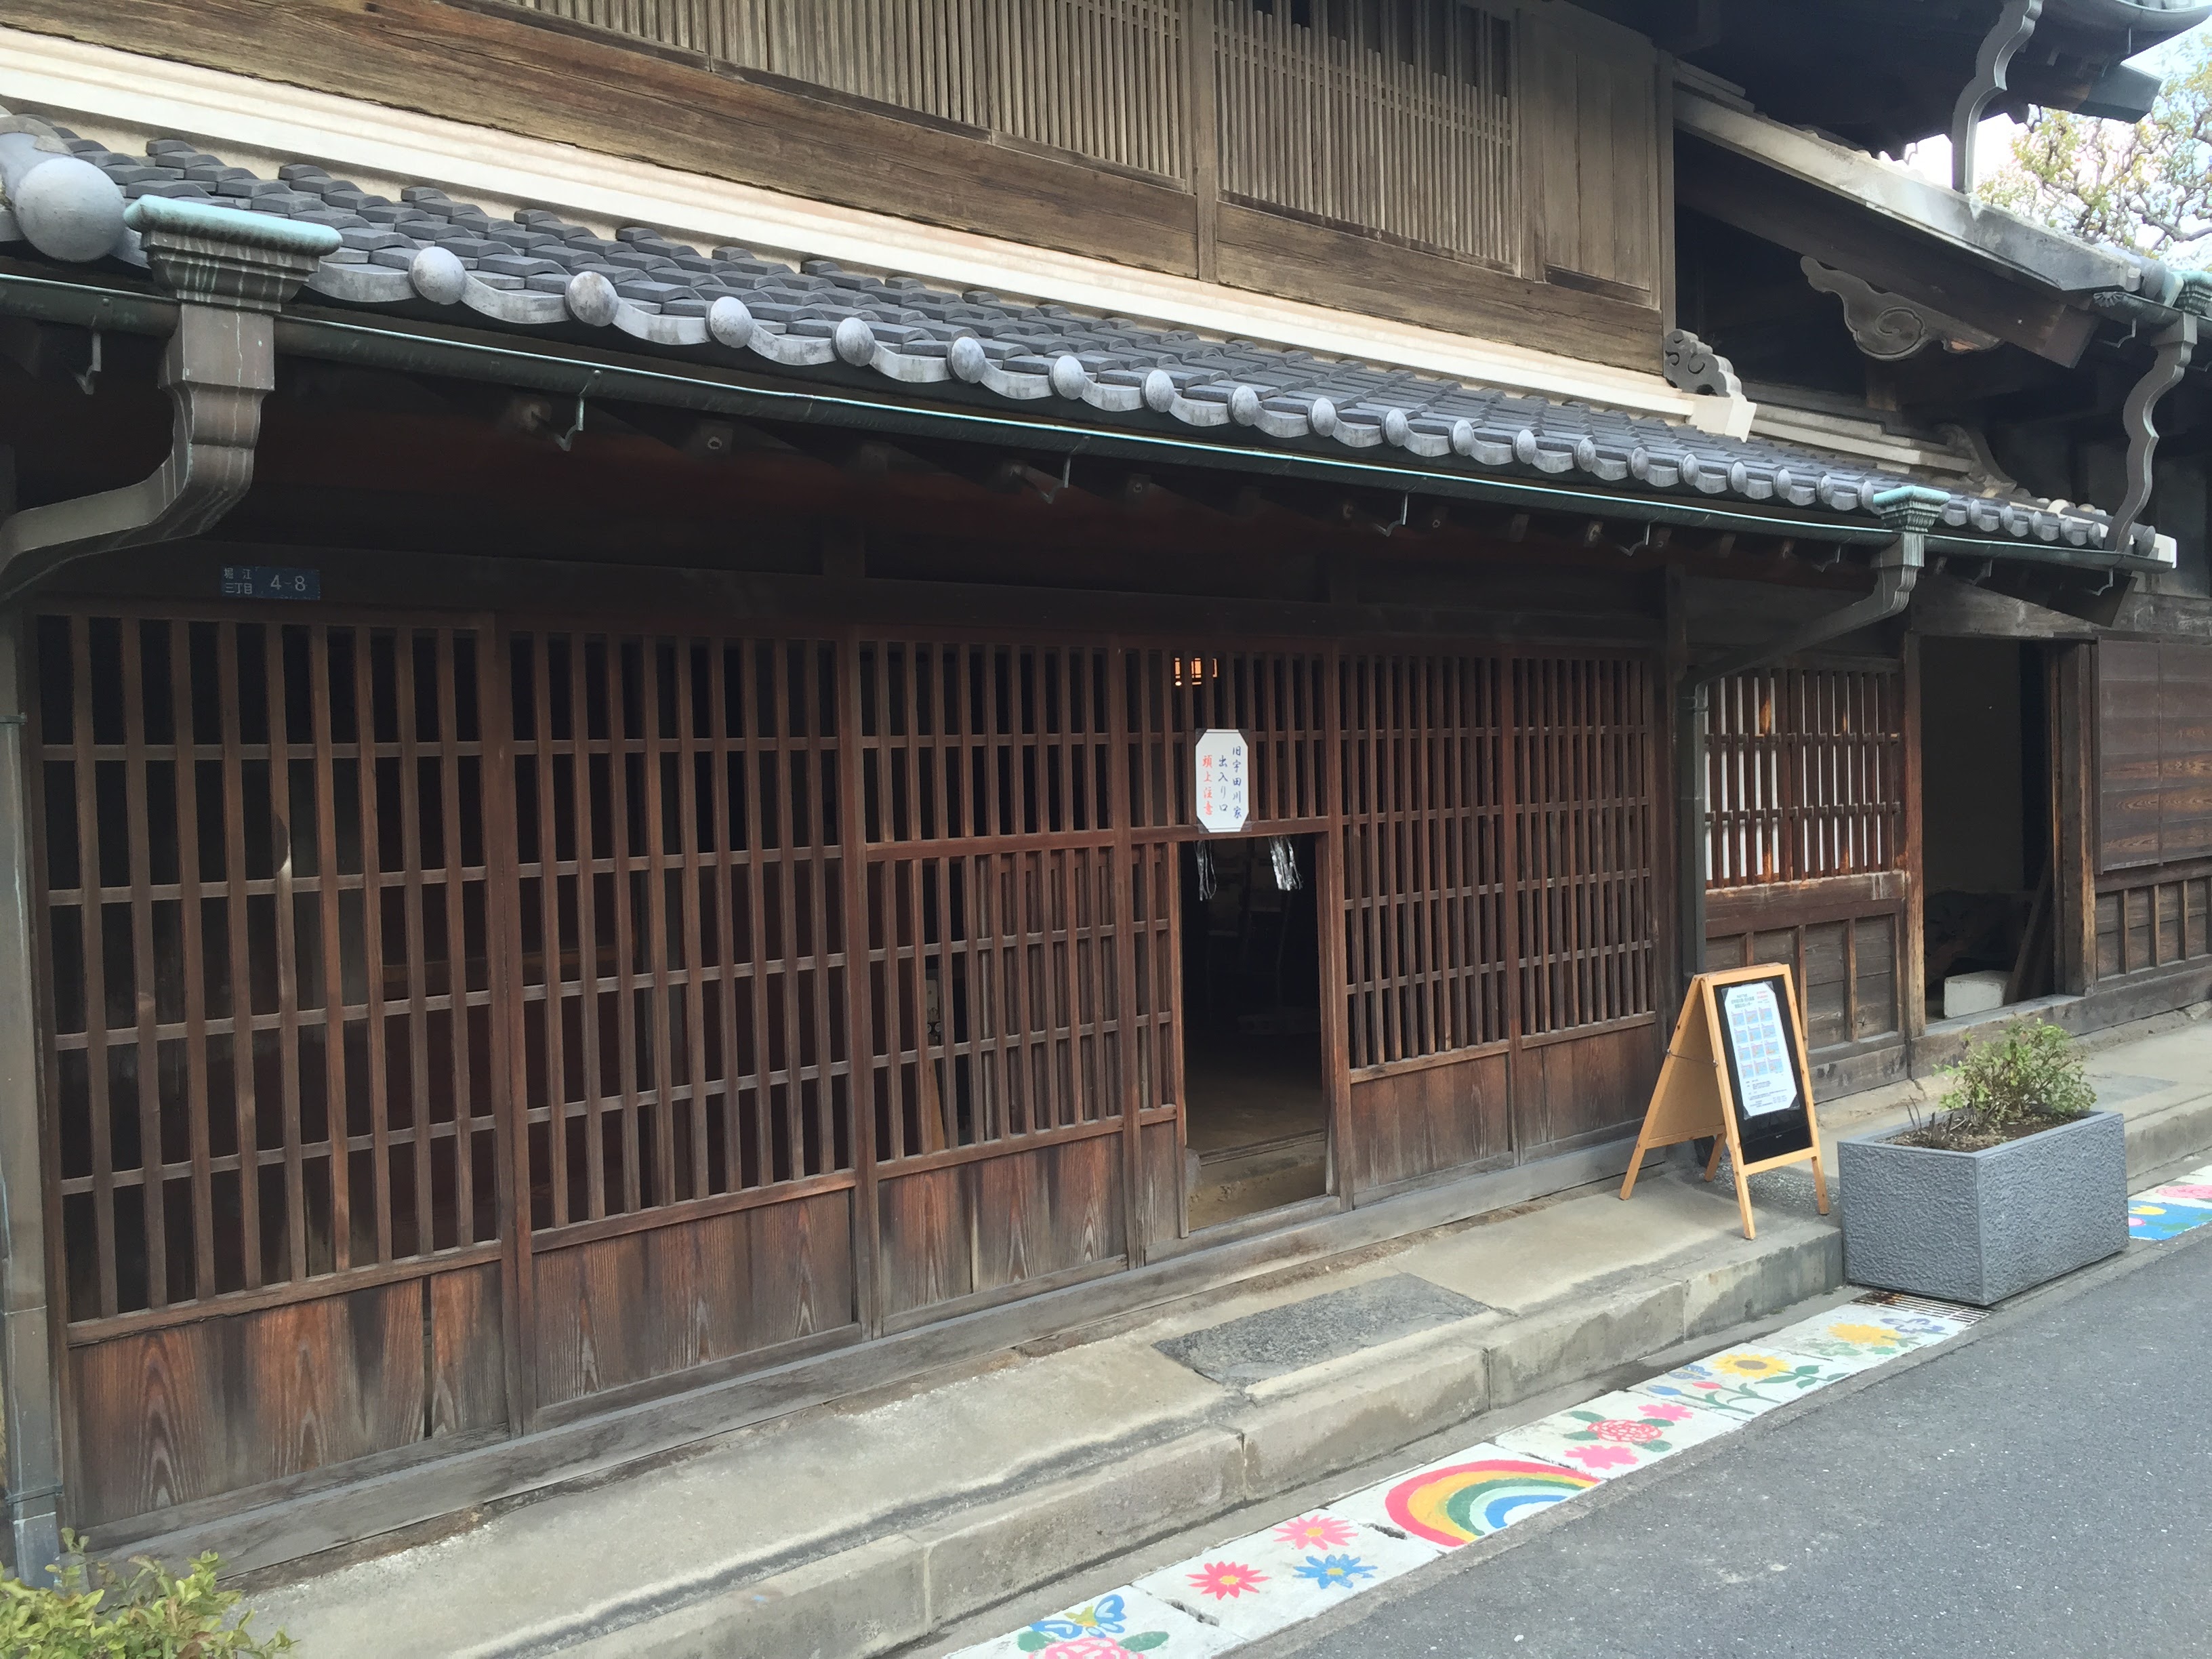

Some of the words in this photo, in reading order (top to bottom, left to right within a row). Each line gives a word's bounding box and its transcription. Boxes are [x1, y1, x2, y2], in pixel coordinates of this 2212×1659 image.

[224, 567, 252, 579] 堀江
[225, 582, 253, 594] 三丁目
[1202, 755, 1213, 815] 頭上注意
[1218, 754, 1228, 811] 出入り口
[1232, 745, 1242, 819] 旧宇田川家
